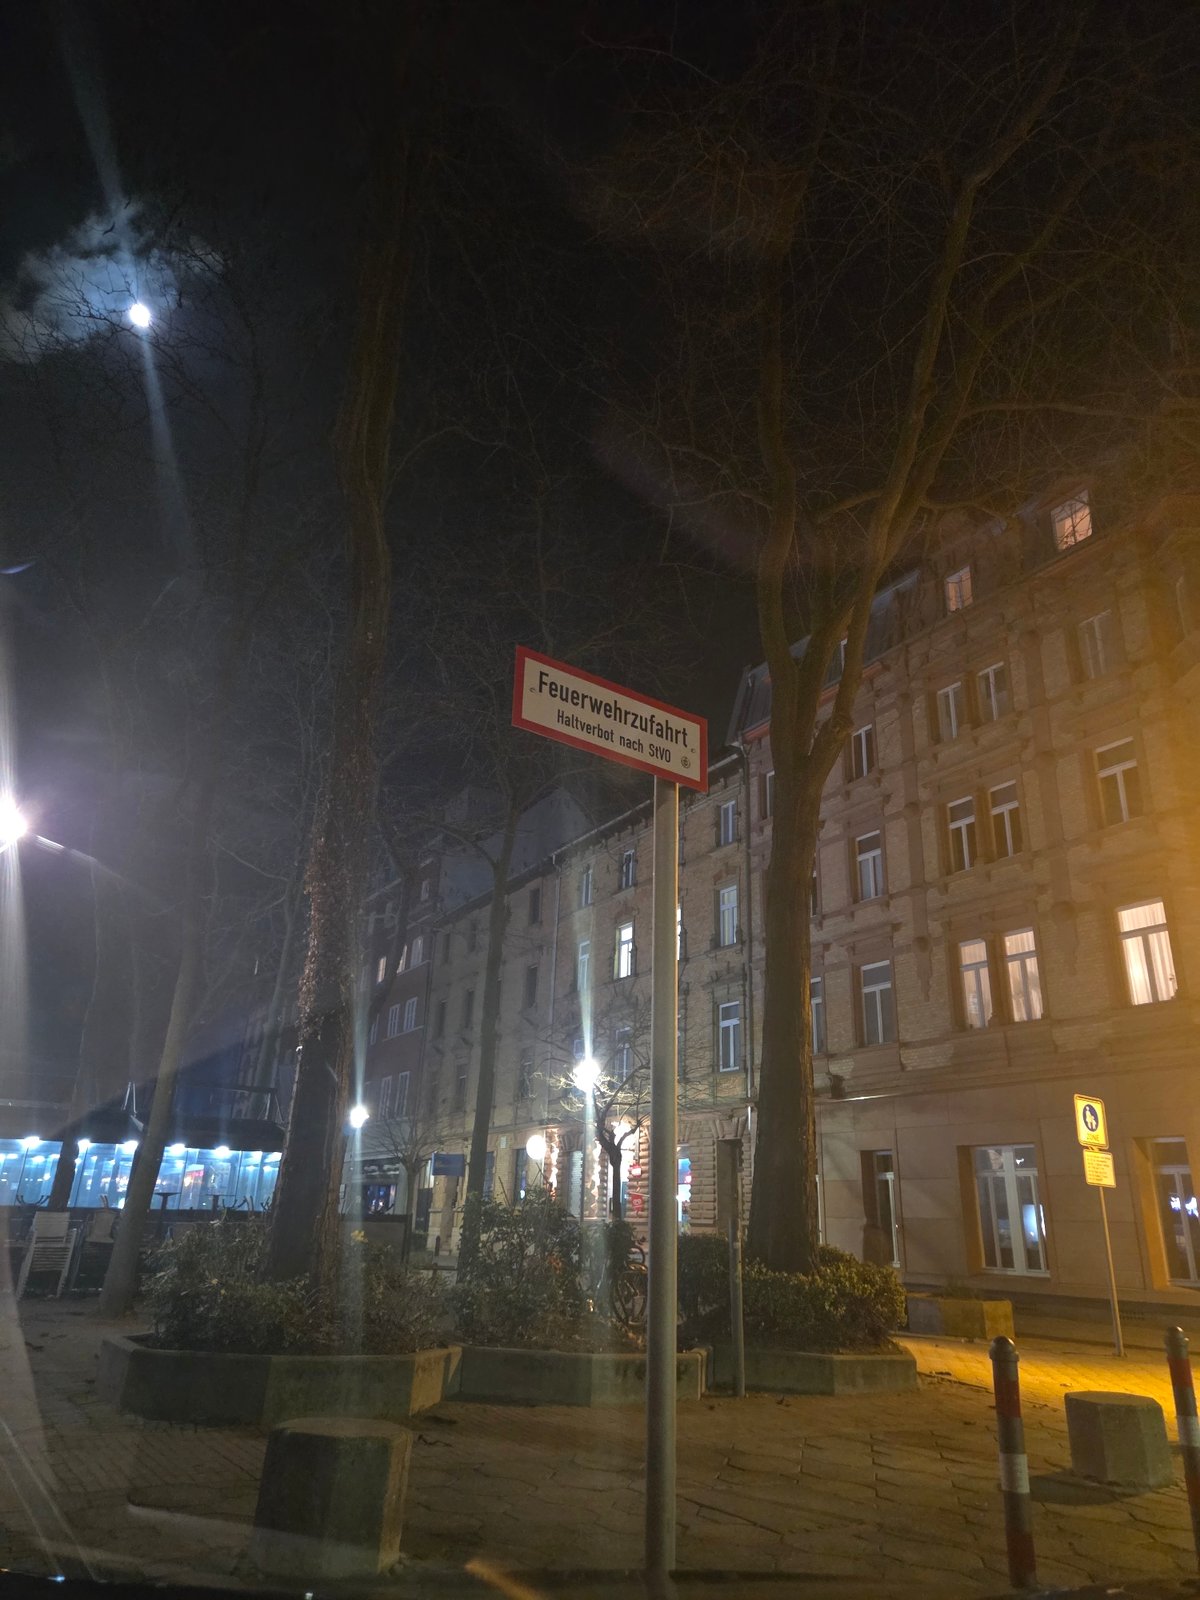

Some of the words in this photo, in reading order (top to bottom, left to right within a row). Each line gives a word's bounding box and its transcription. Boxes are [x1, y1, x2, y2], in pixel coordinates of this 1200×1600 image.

[538, 670, 688, 748] Feuerwehrzufahrt
[557, 709, 615, 743] Haltverbot
[619, 735, 644, 754] nach
[648, 743, 671, 763] StVO
[1086, 1133, 1100, 1142] ZONE
